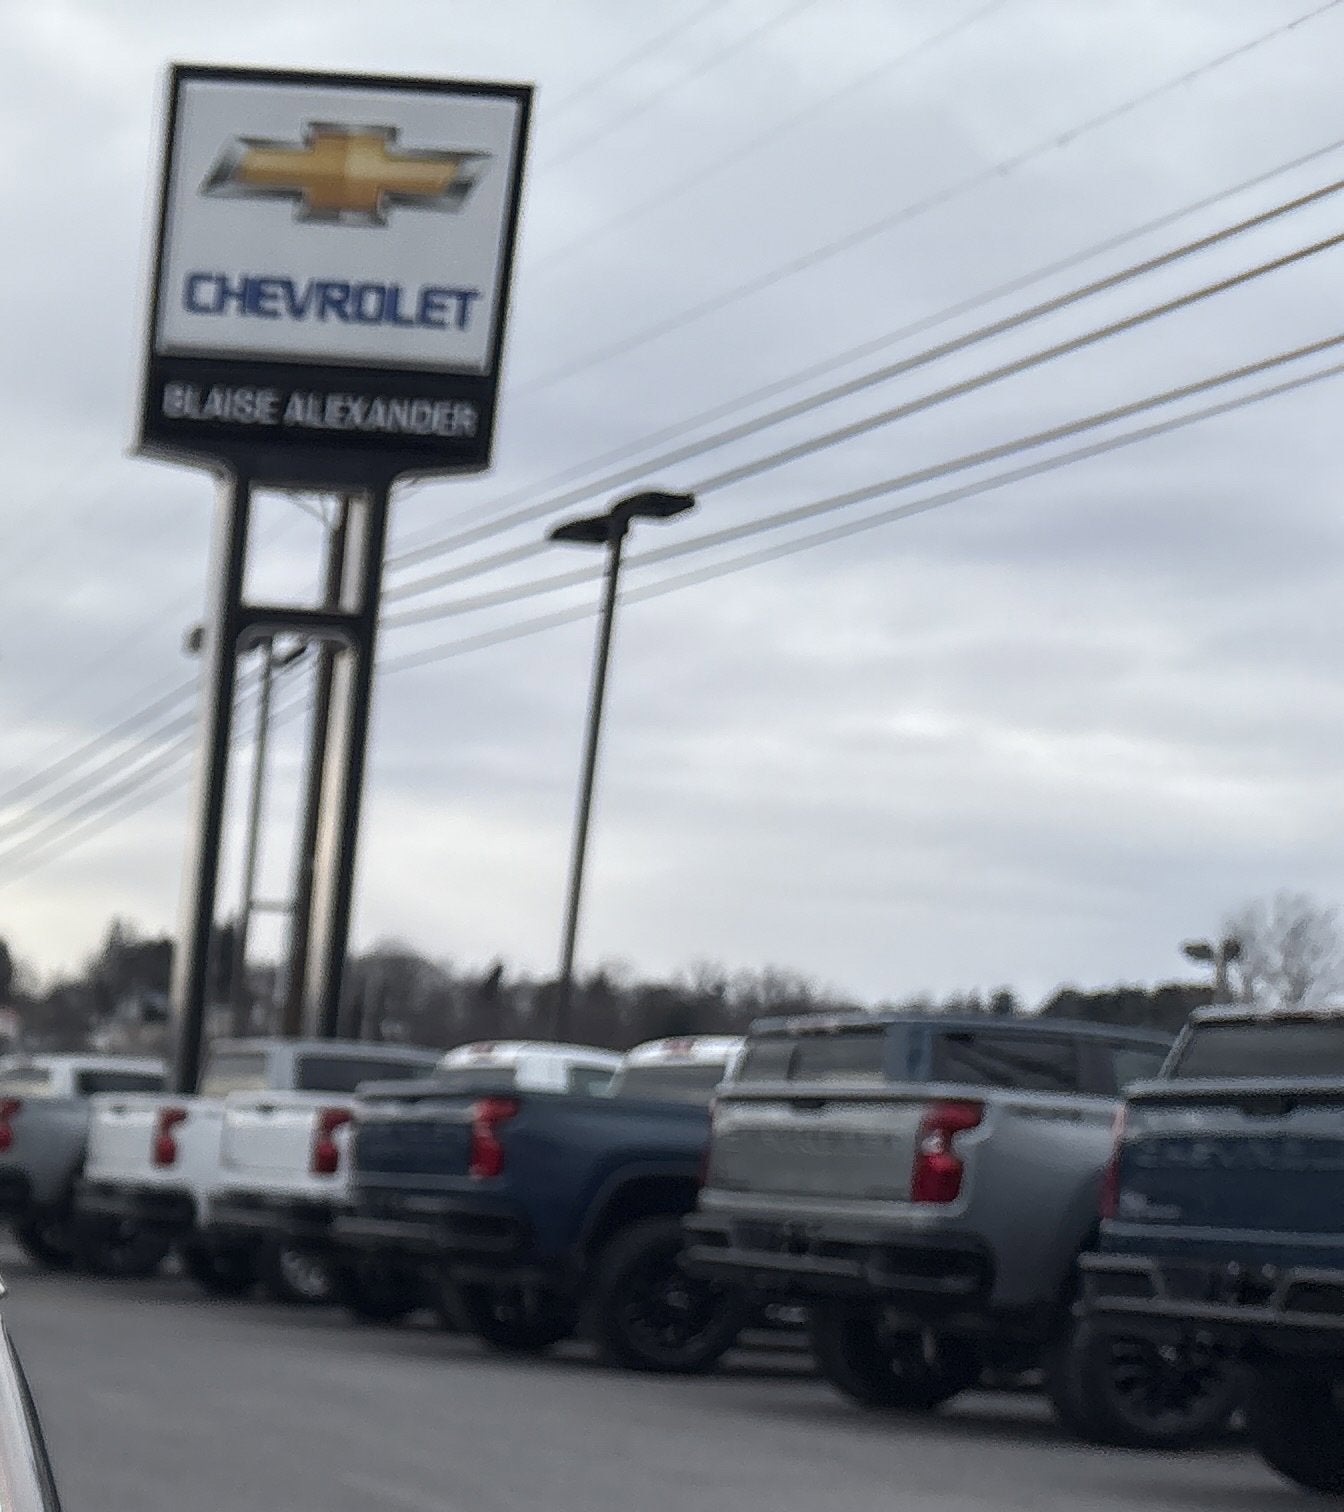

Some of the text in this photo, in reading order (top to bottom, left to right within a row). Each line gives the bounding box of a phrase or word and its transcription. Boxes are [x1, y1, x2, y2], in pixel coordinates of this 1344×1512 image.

[182, 271, 481, 331] CHEVROLET
[162, 381, 480, 438] BLAISE ALEXANDER
